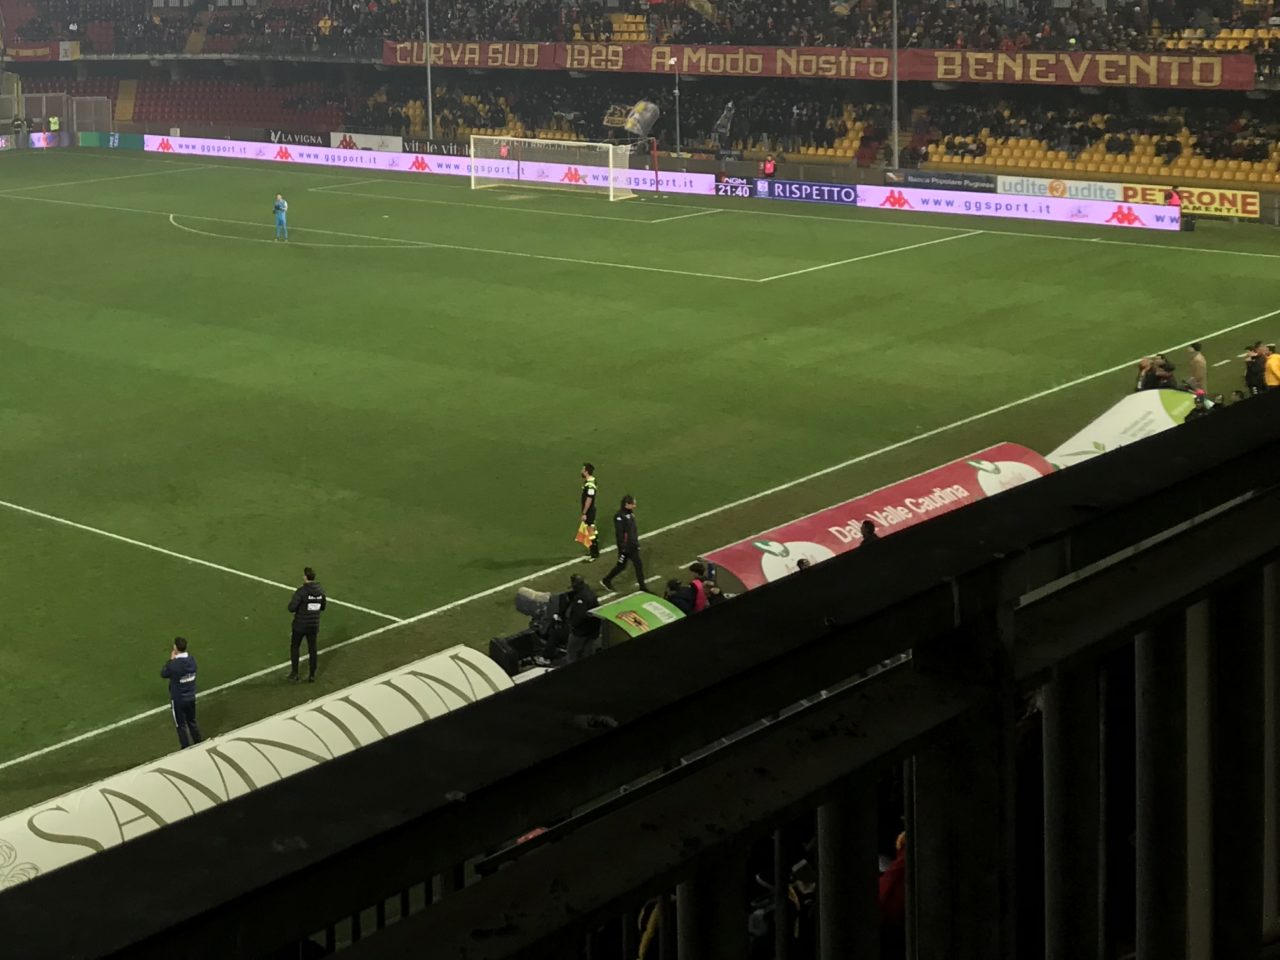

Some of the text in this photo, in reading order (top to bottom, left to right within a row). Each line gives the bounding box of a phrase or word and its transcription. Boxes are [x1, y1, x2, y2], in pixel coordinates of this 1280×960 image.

[396, 41, 1221, 88] CURVA SUD 1929 A Modo Nostro BENEVENTO
[282, 133, 323, 145] LA VIGNA
[298, 150, 377, 166] www.ggsport.it
[436, 160, 525, 176] www.ggsport.t
[718, 184, 750, 198] 21:40
[774, 181, 855, 203] RISPETTO
[1002, 178, 1117, 200] udite udite
[920, 196, 1051, 214] www.ggsport.it
[828, 484, 970, 544] Dall Valle Caudina
